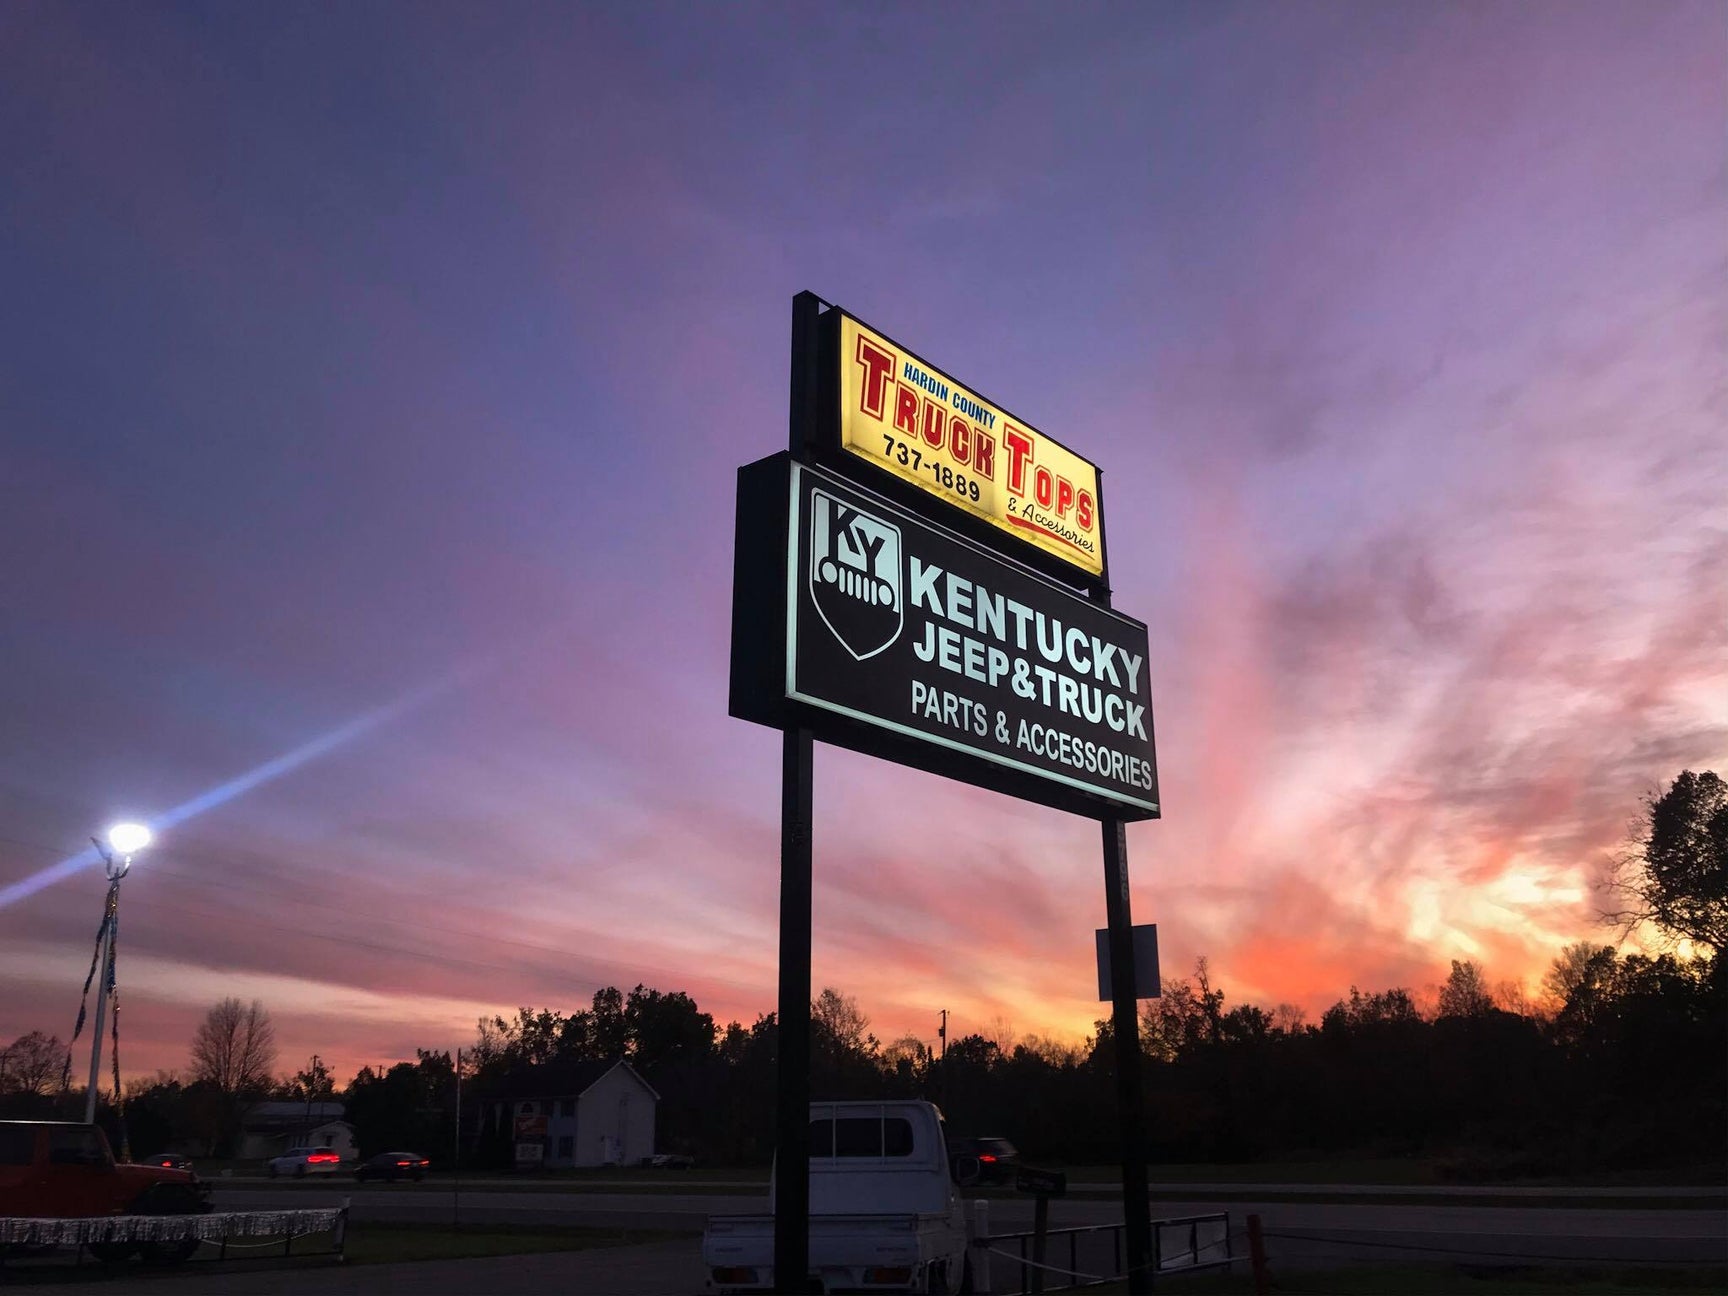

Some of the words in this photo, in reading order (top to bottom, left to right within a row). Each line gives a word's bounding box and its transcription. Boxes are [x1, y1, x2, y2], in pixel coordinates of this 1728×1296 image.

[856, 333, 996, 481] TRUCK
[1003, 422, 1094, 532] TOPS
[904, 362, 948, 402] HARDIN
[952, 392, 996, 430] COUNTY
[883, 434, 980, 502] 737-1889
[1007, 497, 1017, 513] &
[1022, 504, 1095, 553] Accessories
[910, 555, 1143, 695] KENTUCKY
[911, 680, 988, 737] PARTS
[995, 711, 1010, 746] &
[1016, 719, 1153, 791] ACCESSORIES
[913, 621, 1147, 741] JEEP&TRUCK
